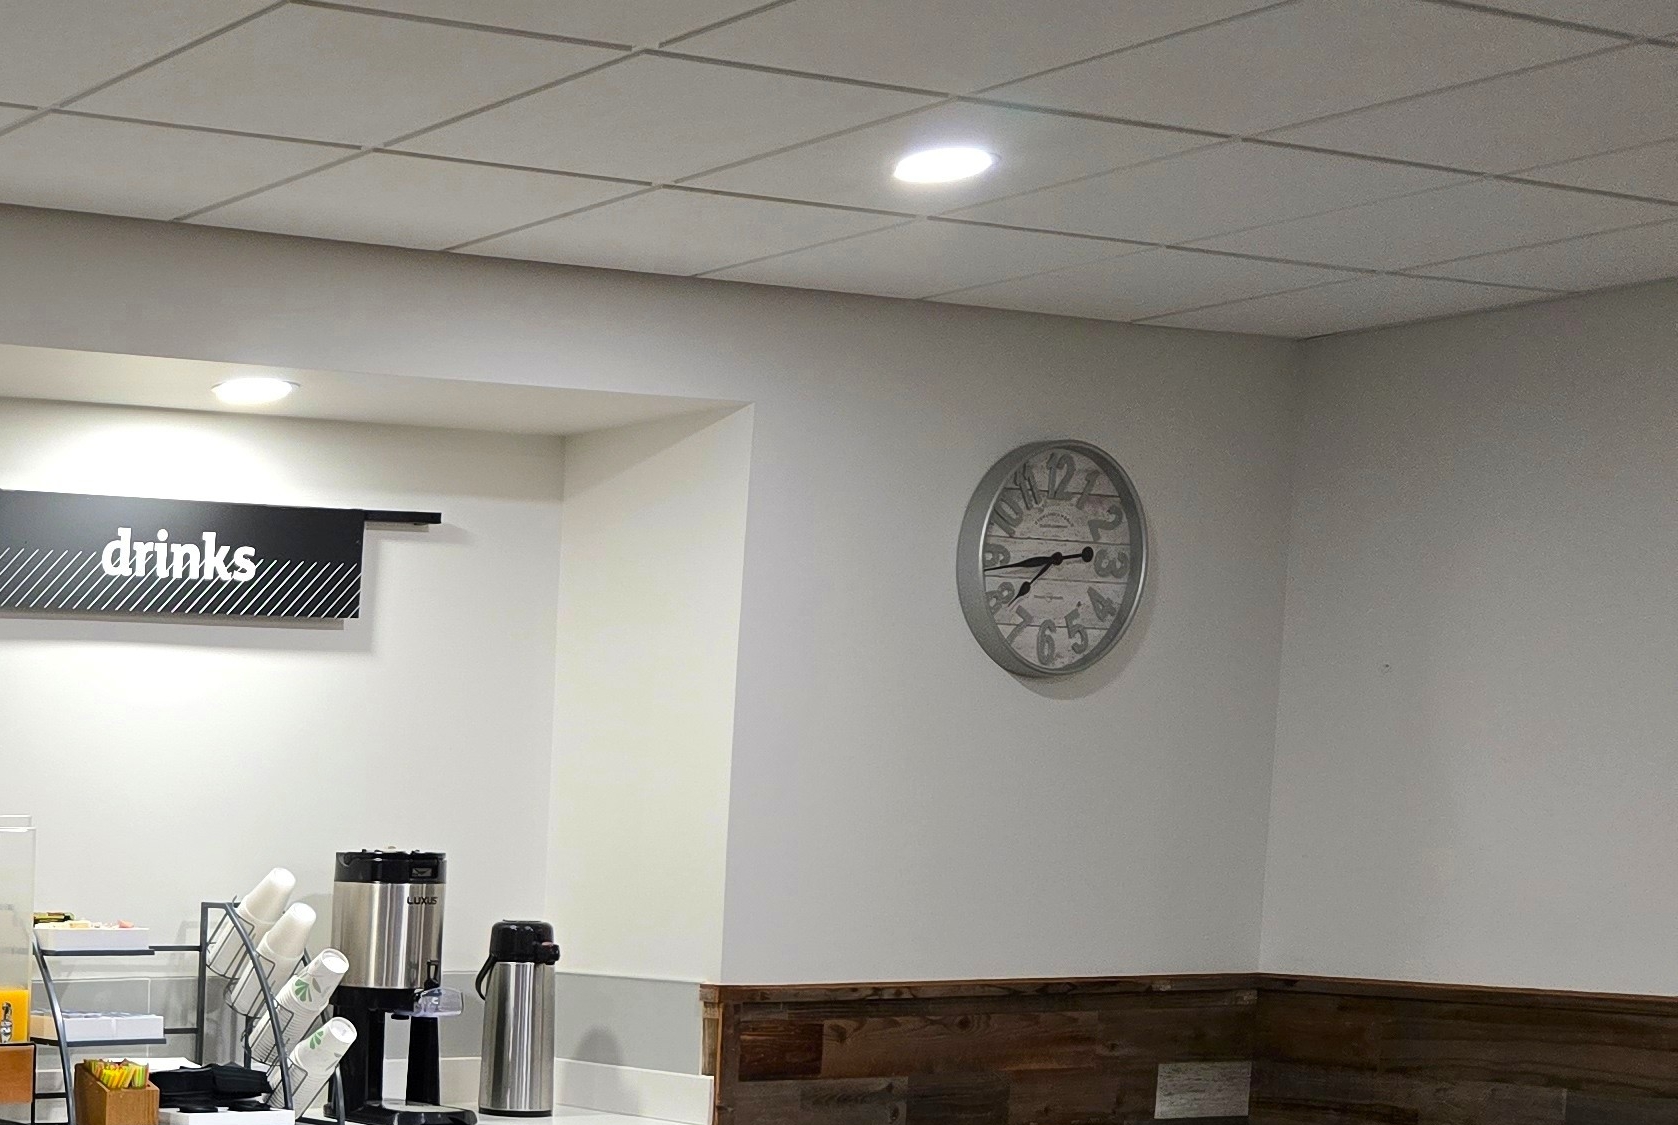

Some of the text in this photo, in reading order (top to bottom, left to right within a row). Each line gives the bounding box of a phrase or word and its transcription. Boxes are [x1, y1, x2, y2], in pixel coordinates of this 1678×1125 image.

[1014, 462, 1042, 511] 11
[1046, 452, 1076, 500] 12
[1075, 469, 1100, 511] 1
[991, 496, 1024, 538] 10
[1088, 504, 1123, 542] 2
[101, 526, 257, 582] drinks
[983, 543, 1011, 567] 9
[1093, 548, 1130, 579] 3
[985, 581, 1015, 616] 8
[1087, 586, 1117, 622] 4
[1005, 604, 1034, 645] 7
[1036, 619, 1057, 666] 6
[1064, 607, 1089, 655] 5
[407, 896, 438, 905] LUXUS
